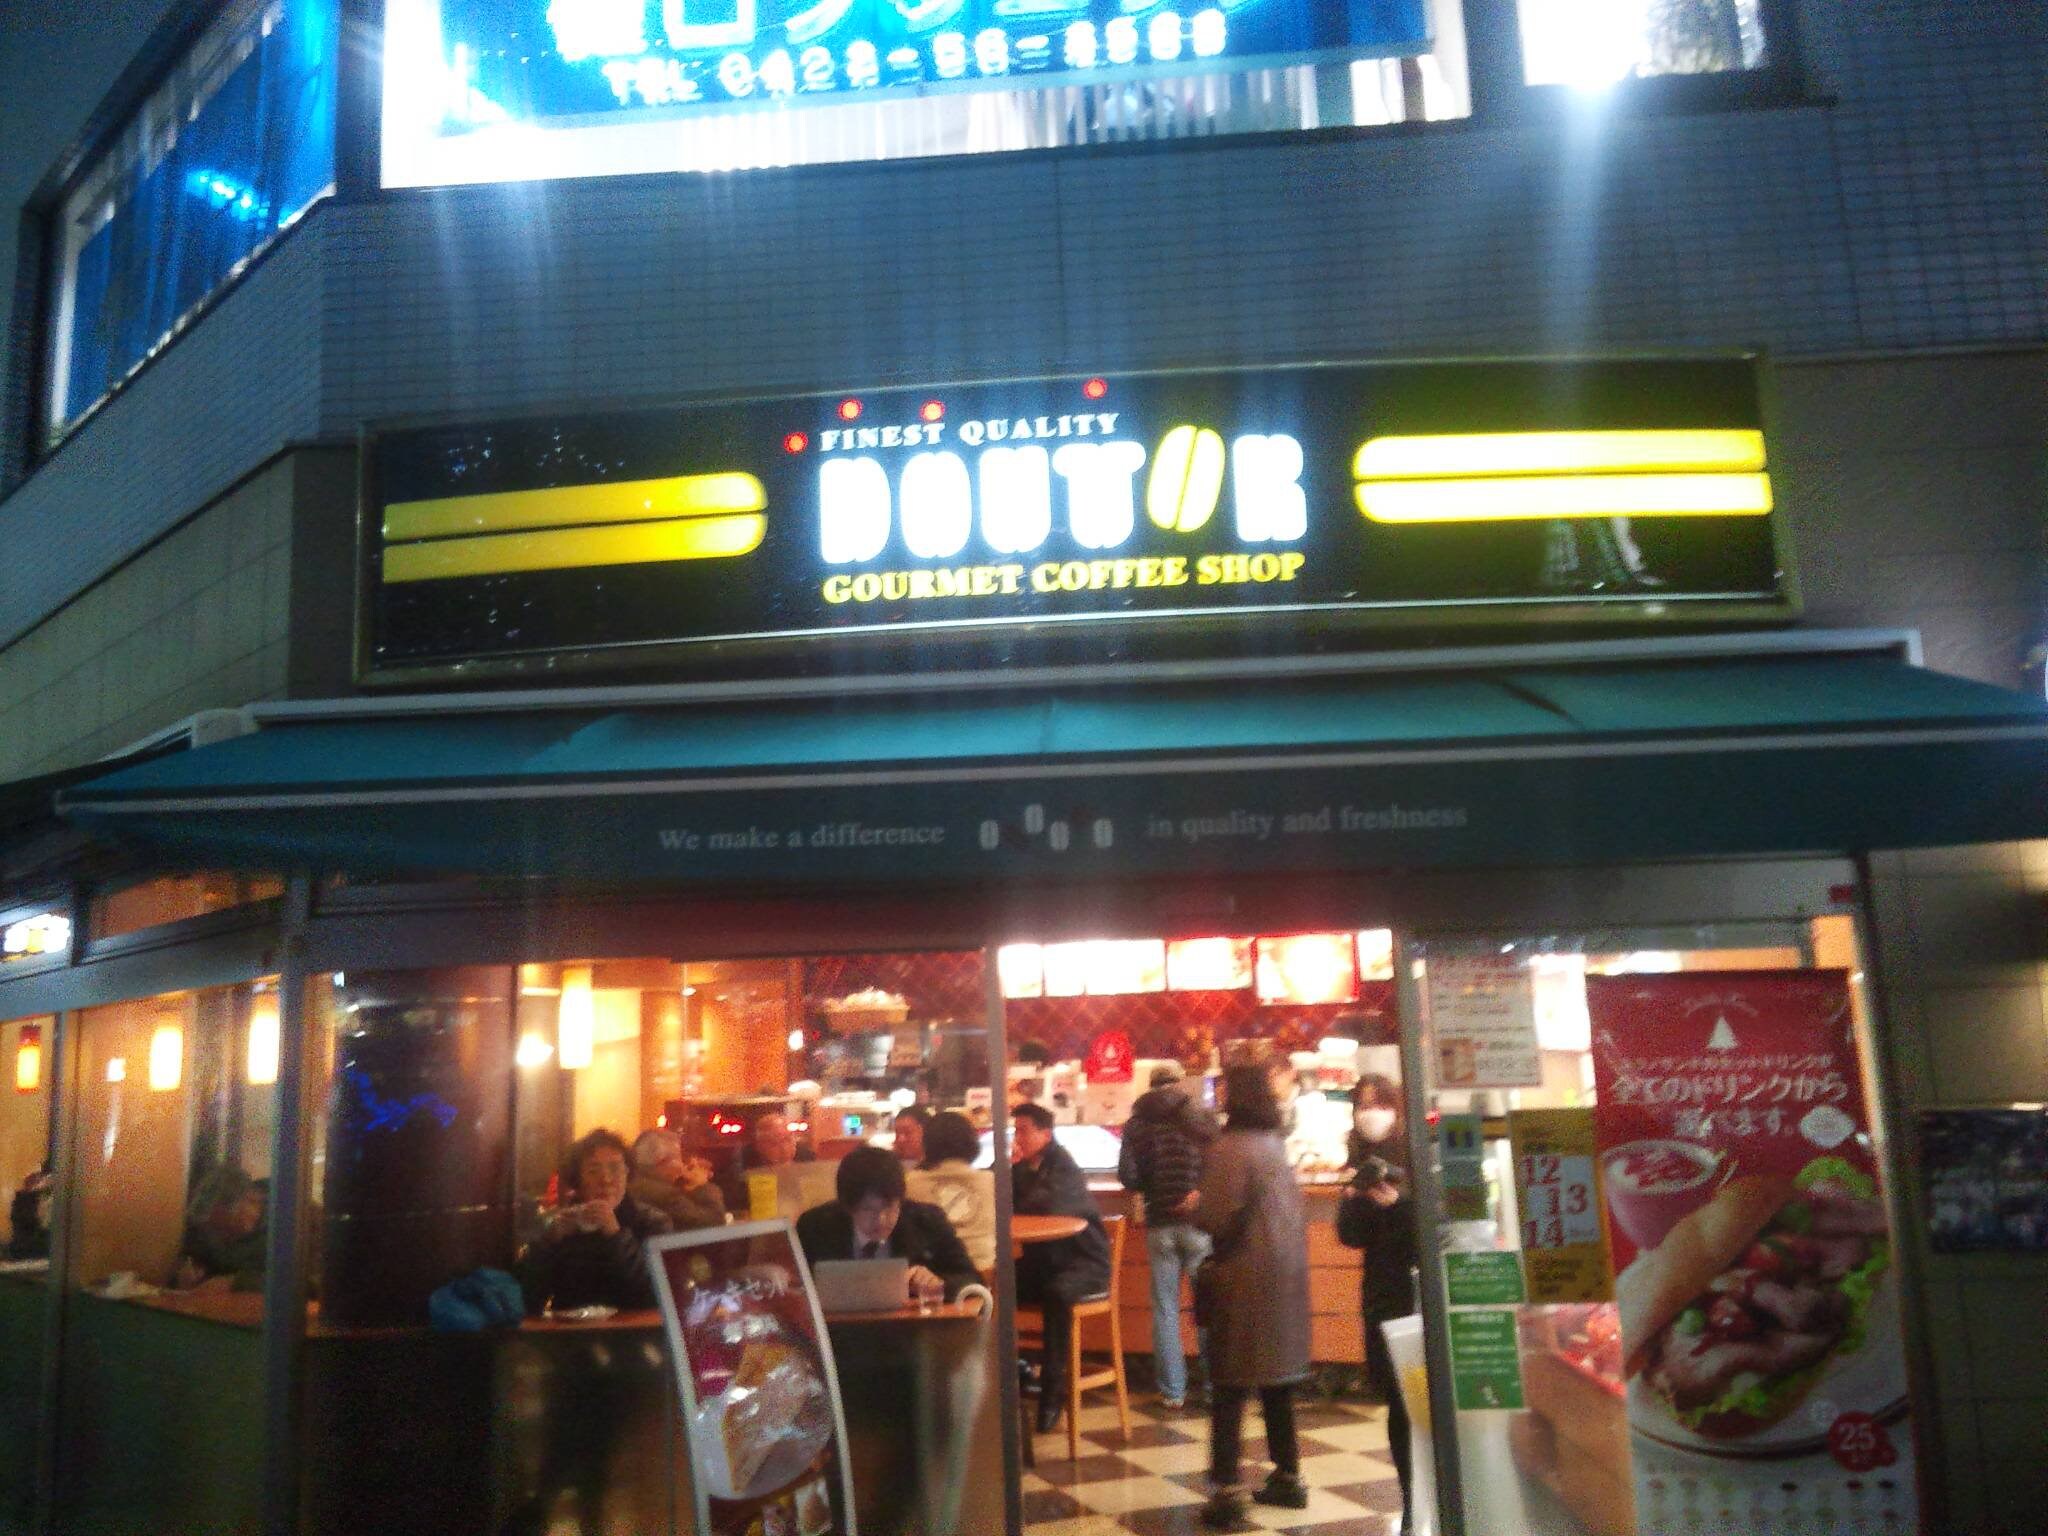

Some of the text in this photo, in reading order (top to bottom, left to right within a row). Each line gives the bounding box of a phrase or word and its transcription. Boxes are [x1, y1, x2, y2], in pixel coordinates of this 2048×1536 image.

[819, 412, 1120, 453] FINEST QUALITY
[818, 424, 1308, 565] DOUTOR
[822, 552, 1306, 605] GOURMET COFFEE SHOP
[659, 822, 946, 851] We make a difference
[1147, 803, 1468, 842] in quality and freshness
